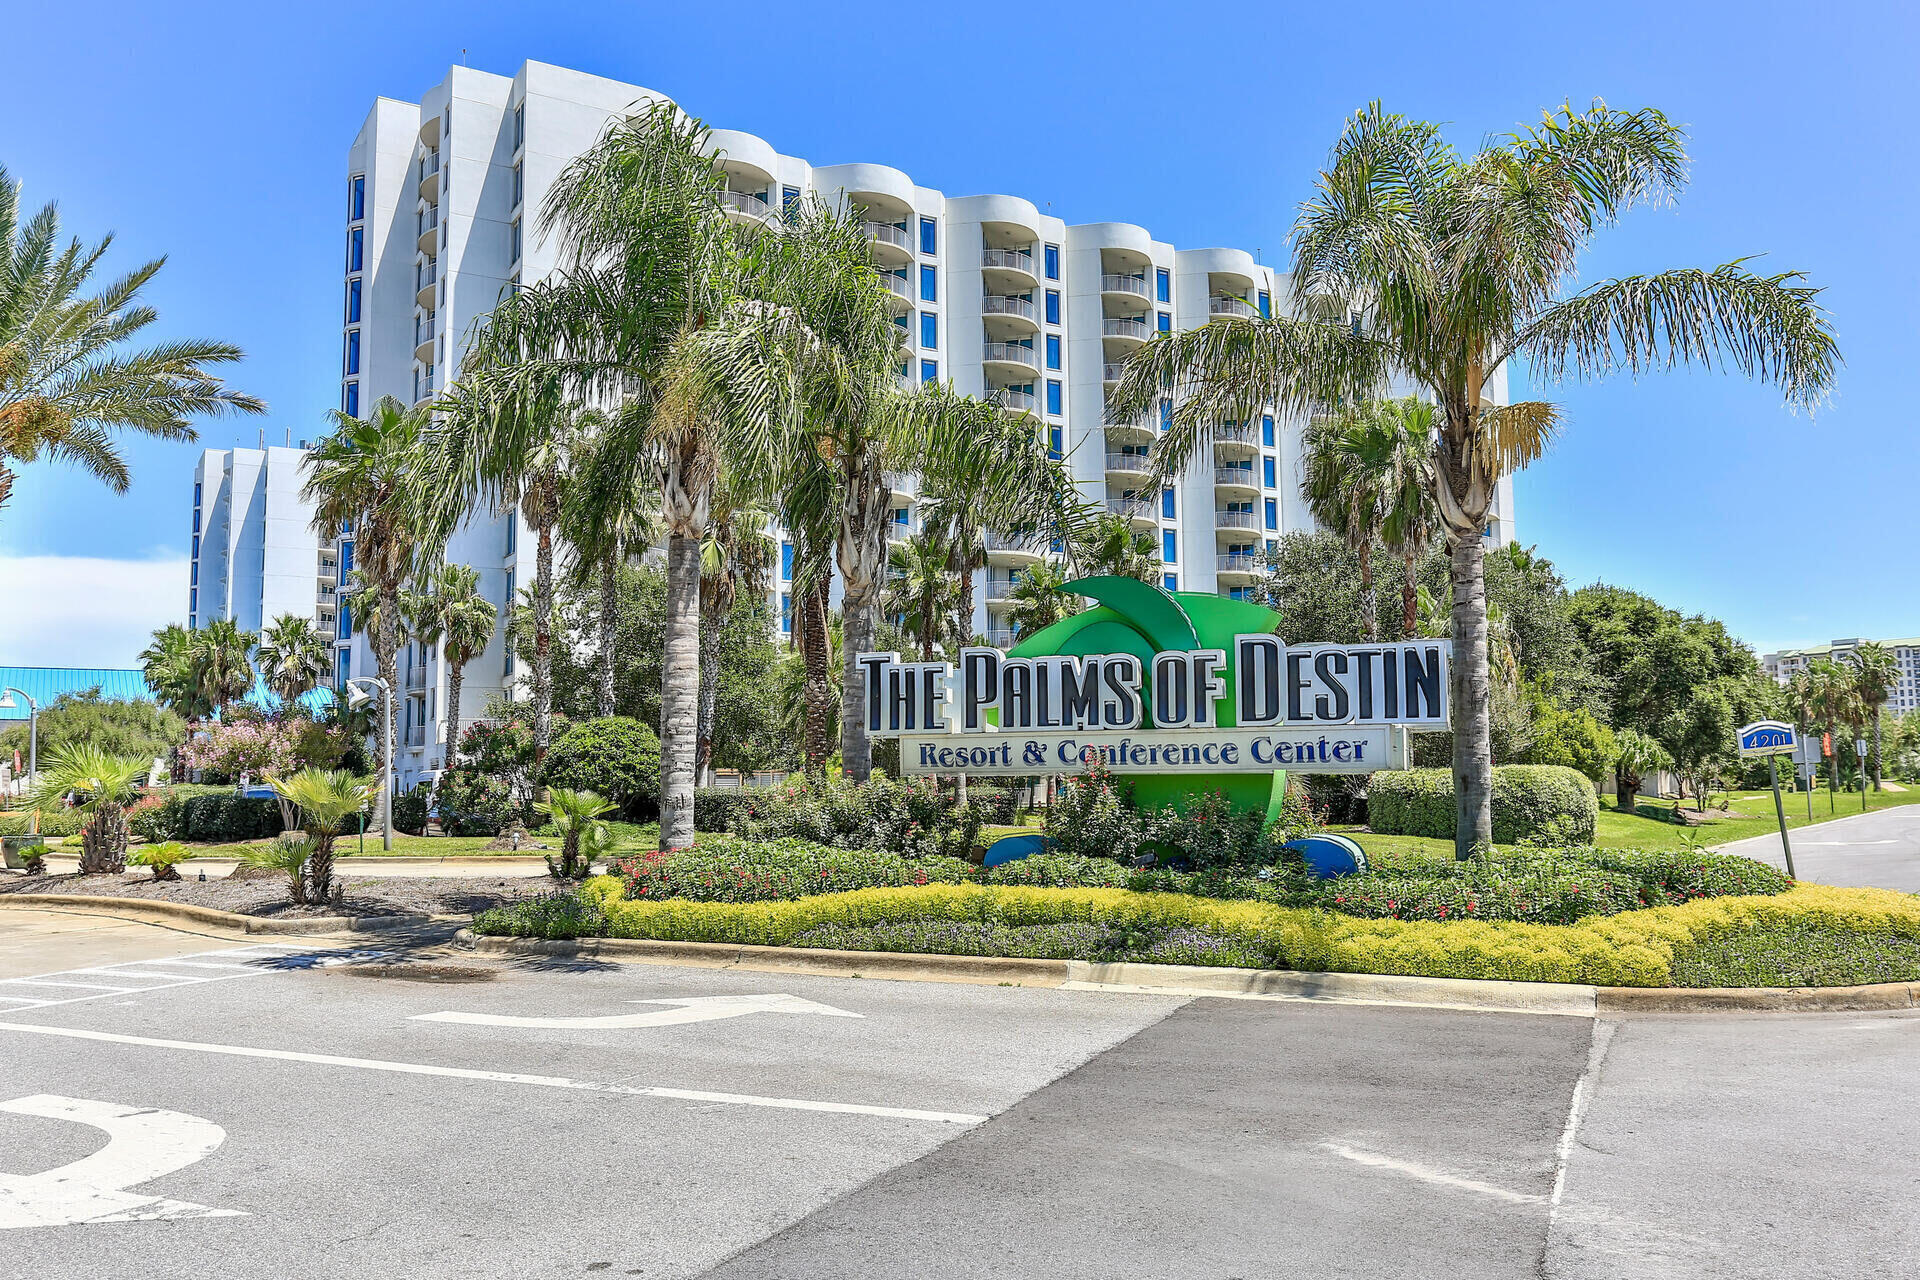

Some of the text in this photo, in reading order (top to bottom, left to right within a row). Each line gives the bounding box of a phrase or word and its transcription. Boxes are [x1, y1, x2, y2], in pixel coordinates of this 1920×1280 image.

[858, 637, 1444, 732] THE PALMS OF DESTIN
[919, 735, 1368, 767] Resort & Conference Center
[1750, 733, 1786, 748] 4201
